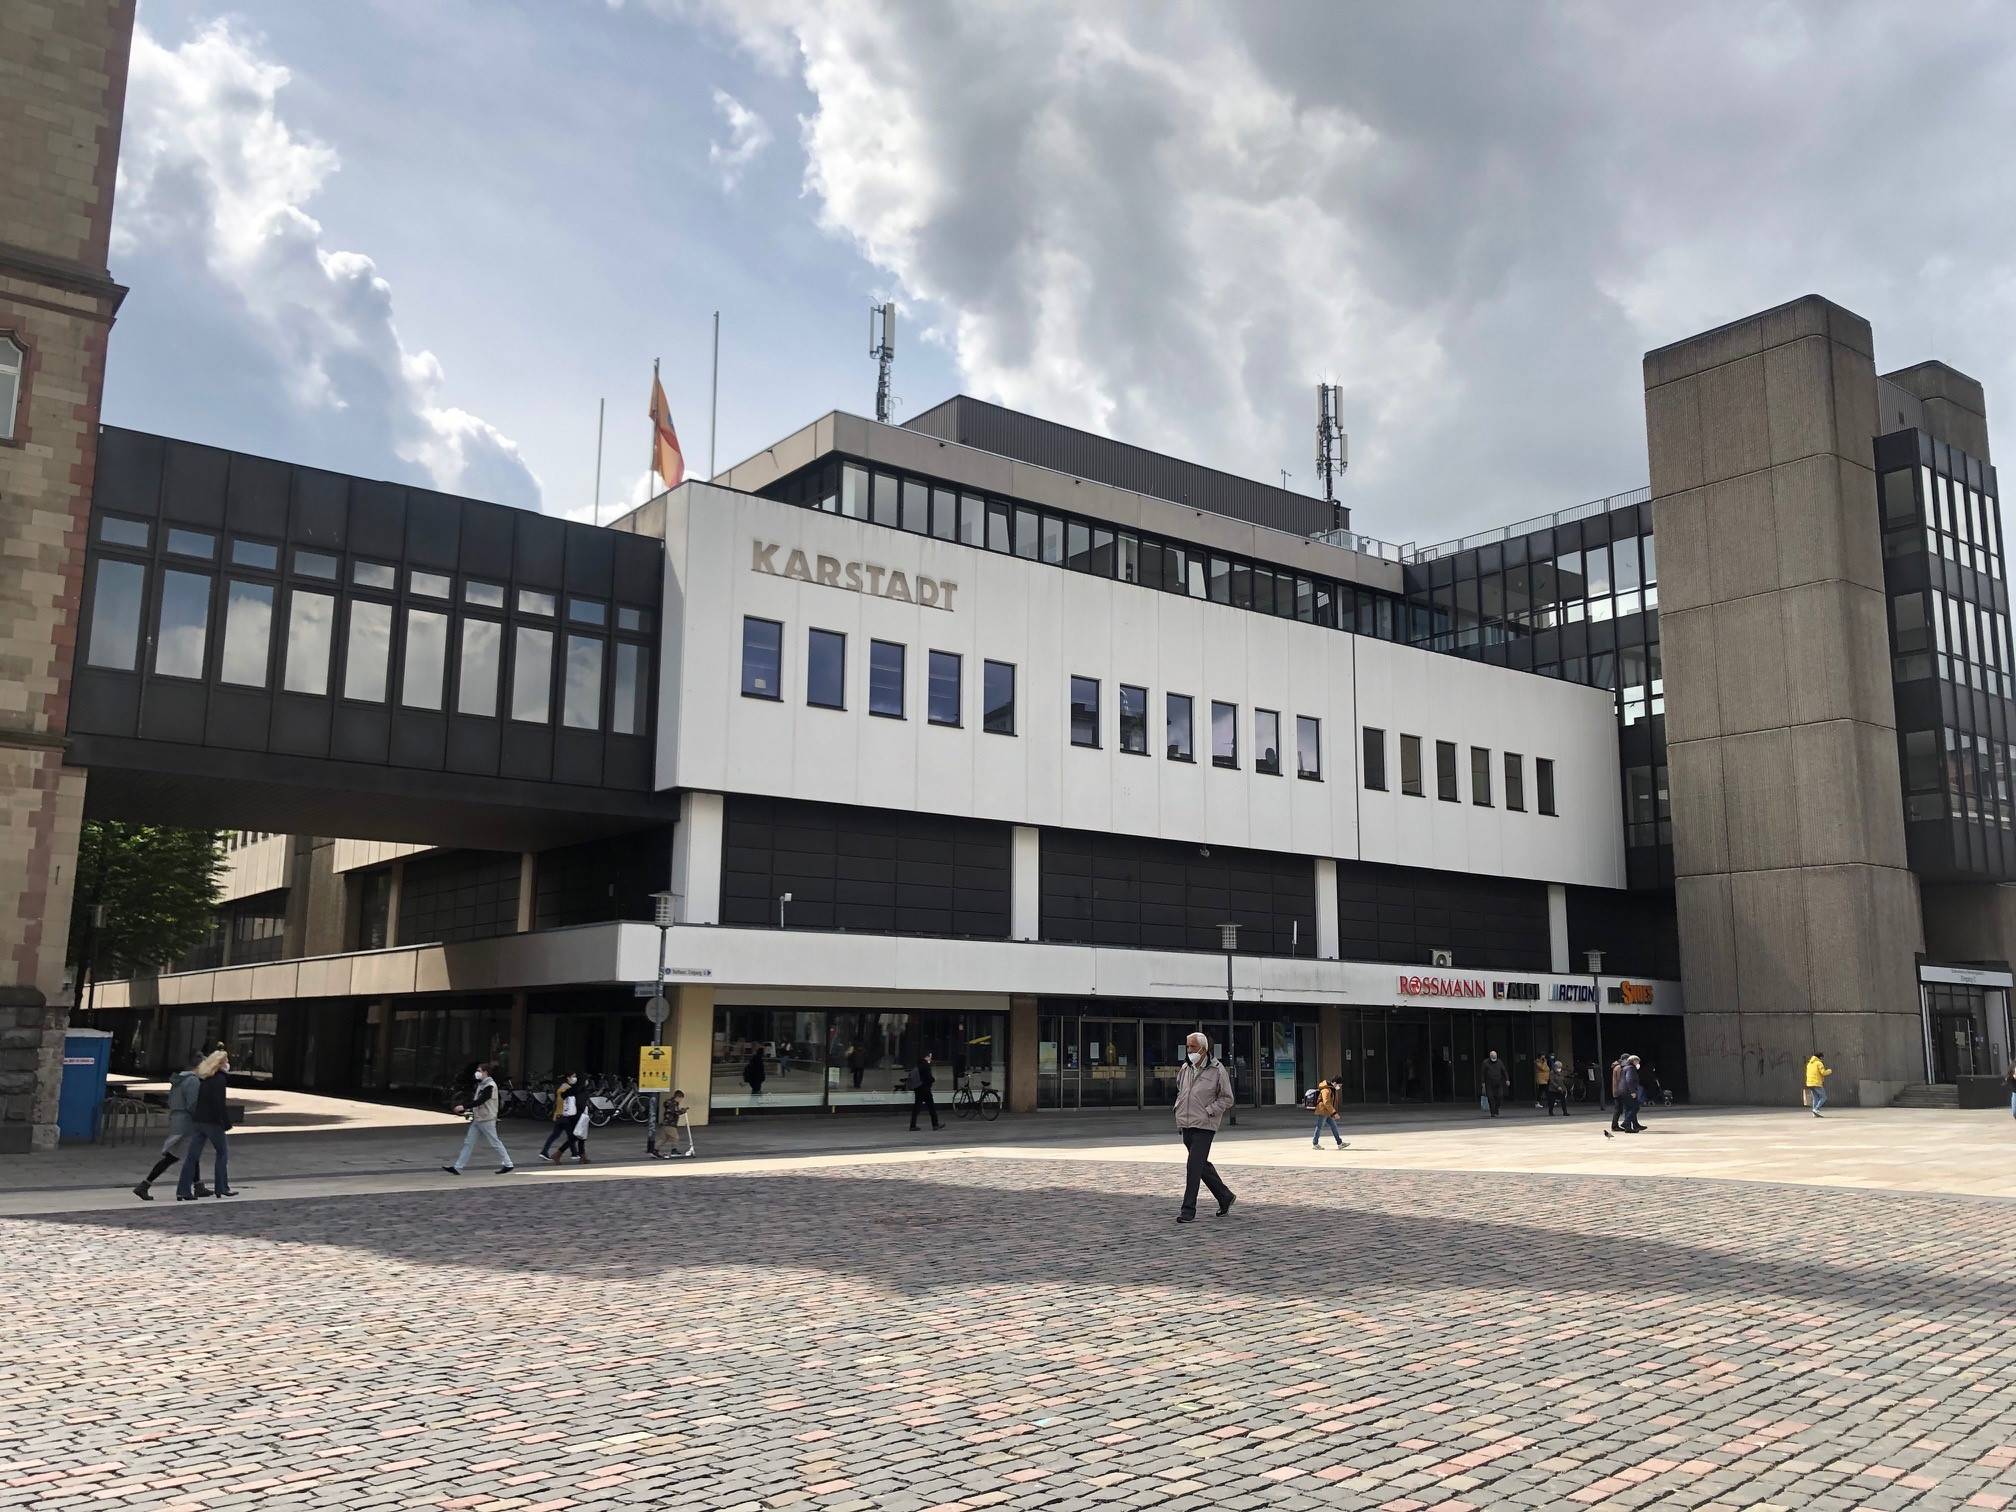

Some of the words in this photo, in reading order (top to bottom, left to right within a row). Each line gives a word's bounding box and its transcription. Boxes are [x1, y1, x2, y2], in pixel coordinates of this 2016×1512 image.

[752, 540, 958, 611] KARSTADT
[1399, 975, 1486, 998] ROSSMANN
[1506, 982, 1541, 1001] ALDI
[1558, 984, 1596, 1002] ACTION
